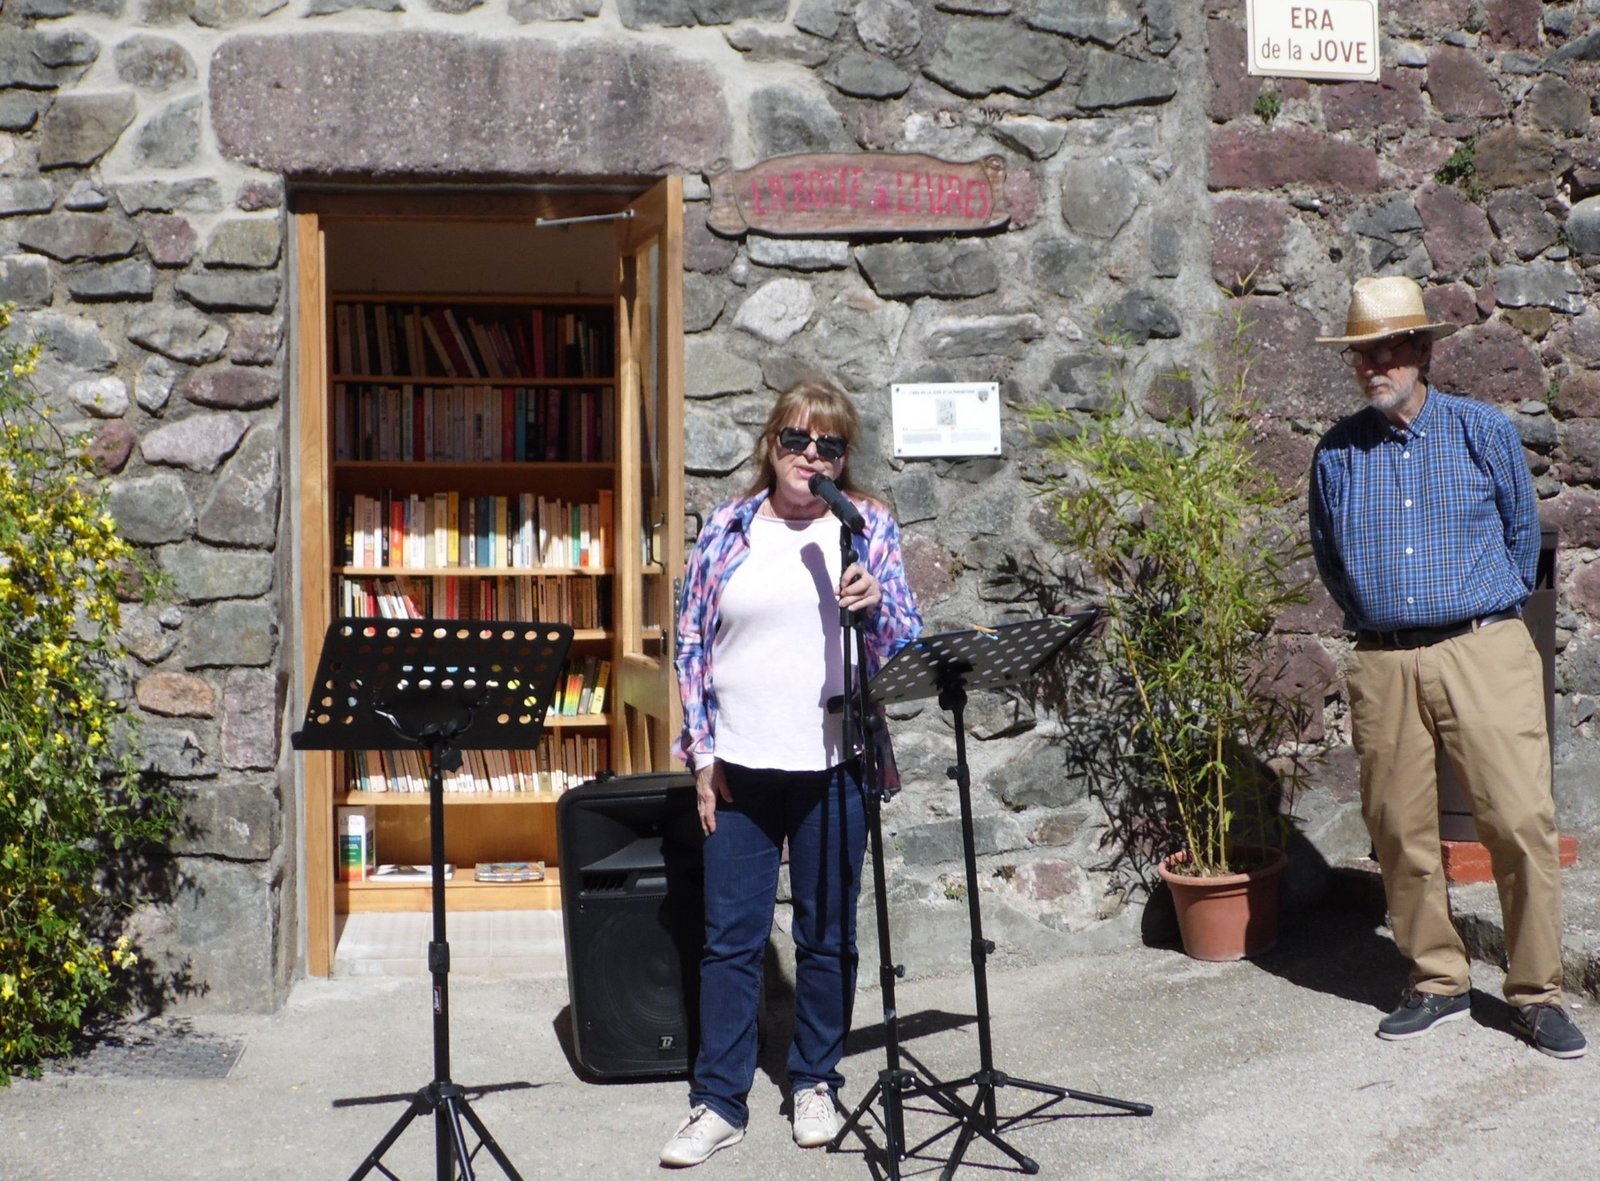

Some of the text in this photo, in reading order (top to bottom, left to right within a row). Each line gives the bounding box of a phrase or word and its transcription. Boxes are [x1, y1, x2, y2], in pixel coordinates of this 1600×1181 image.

[1291, 7, 1334, 31] ERA
[1261, 37, 1367, 63] de la JOVE
[751, 176, 787, 216] LA
[896, 171, 989, 218] LIVRES
